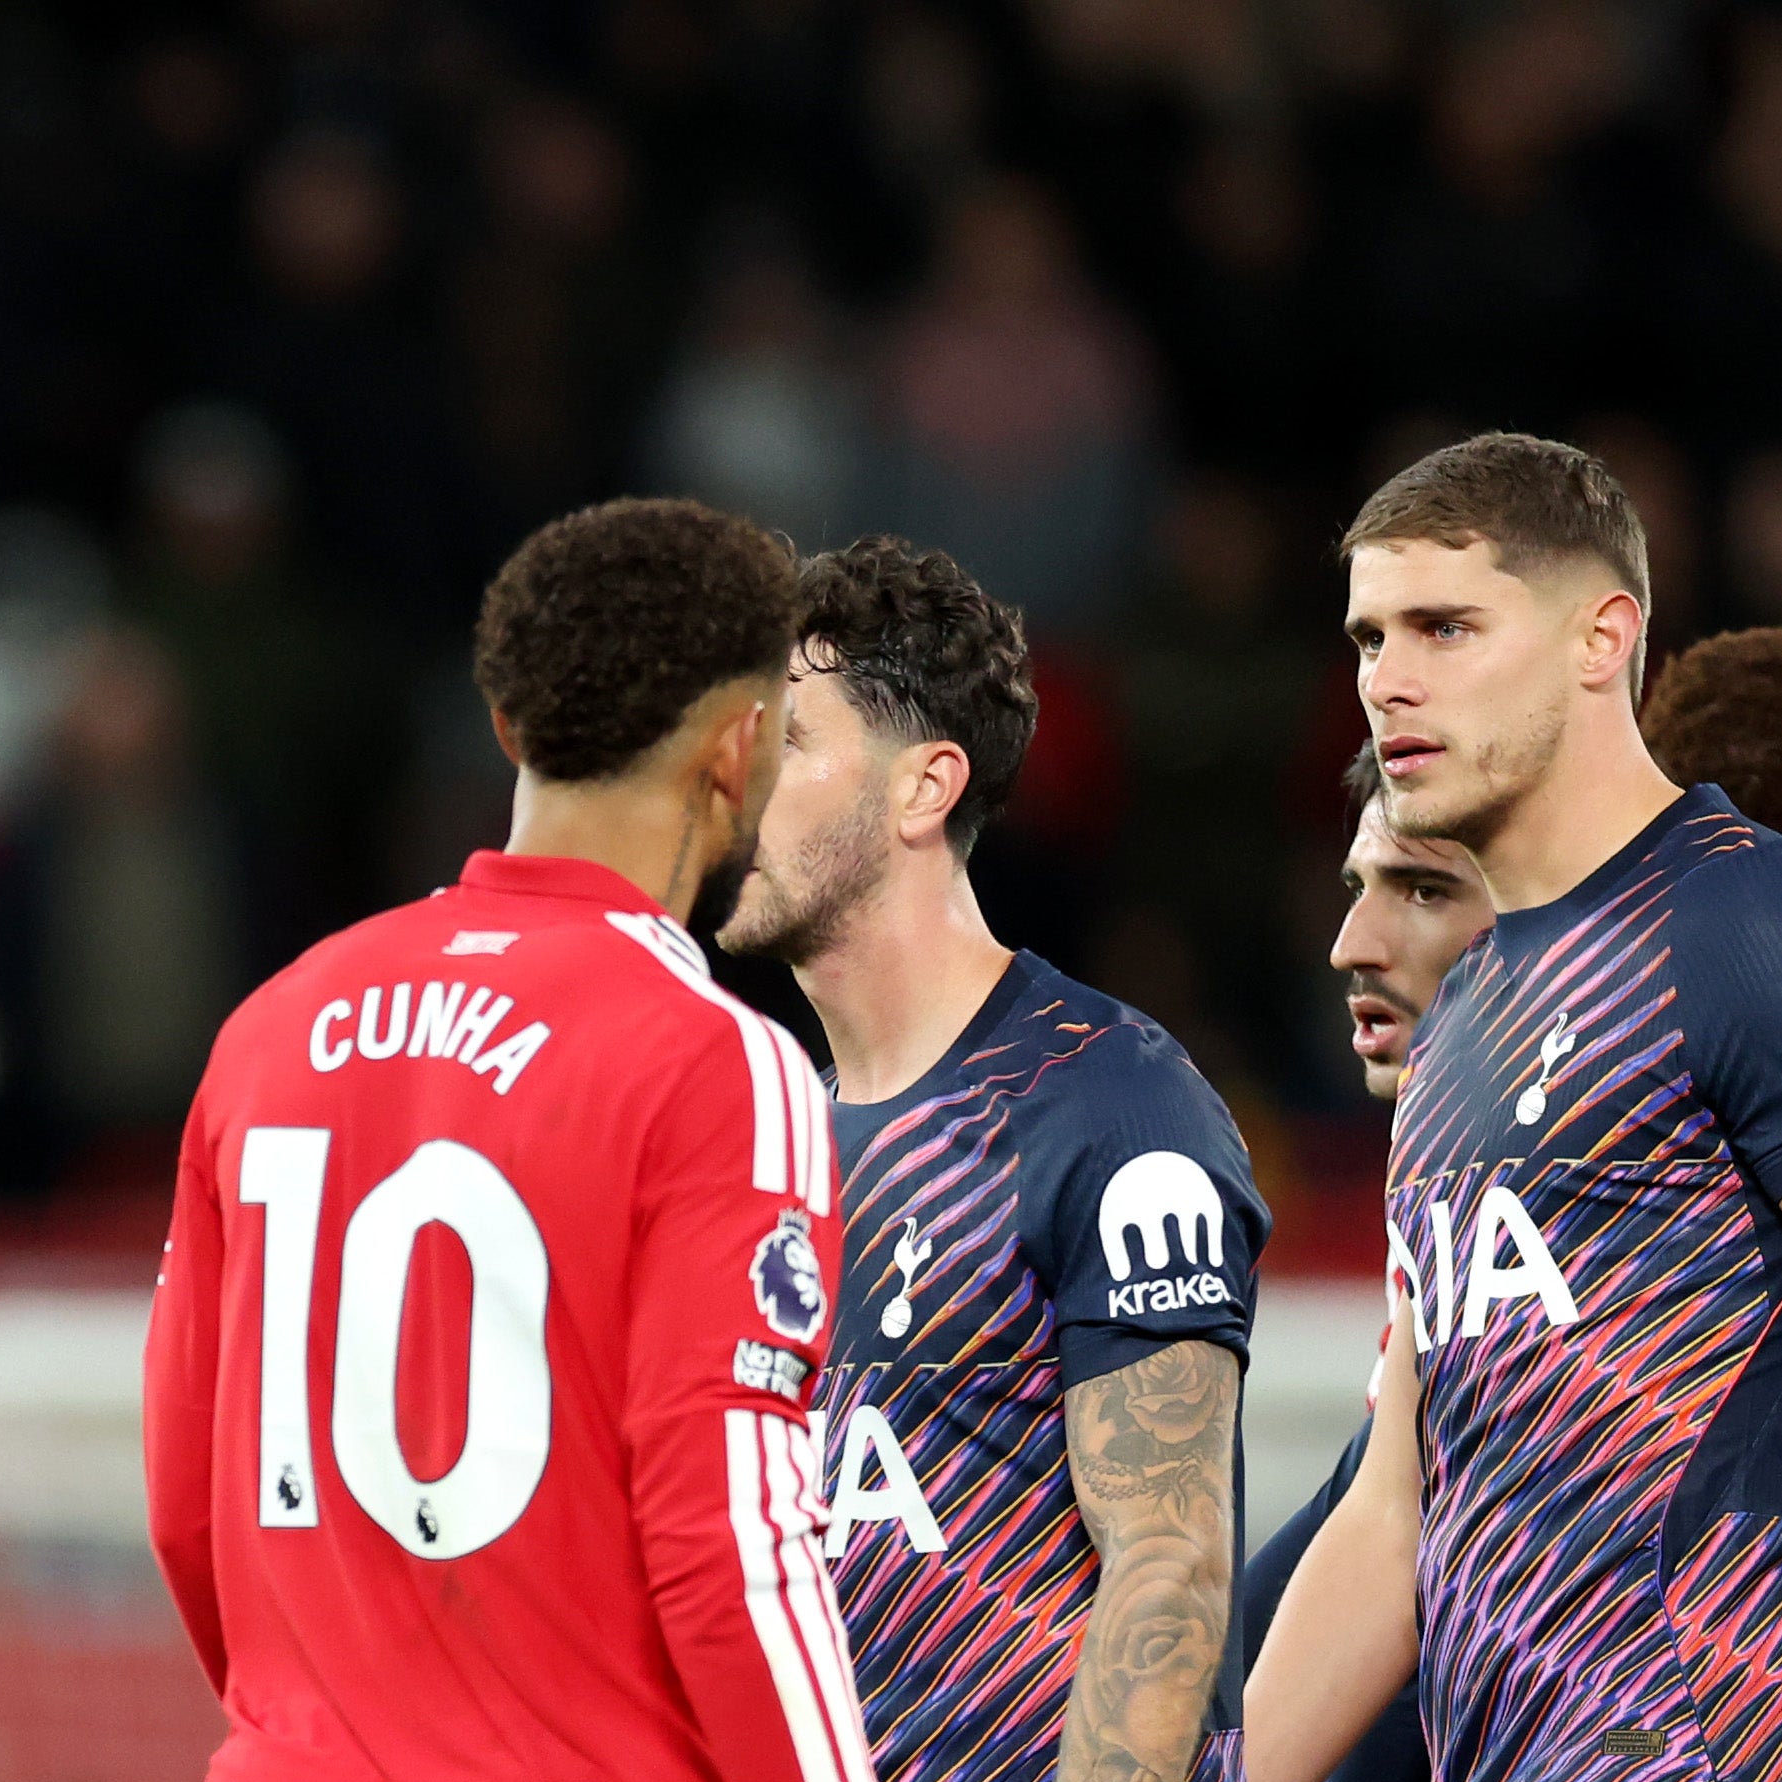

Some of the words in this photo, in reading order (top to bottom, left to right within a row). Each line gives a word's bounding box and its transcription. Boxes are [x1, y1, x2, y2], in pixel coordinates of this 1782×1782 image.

[309, 980, 551, 1095] CUNHA
[239, 1127, 553, 1561] 10
[1108, 1271, 1232, 1318] kraken
